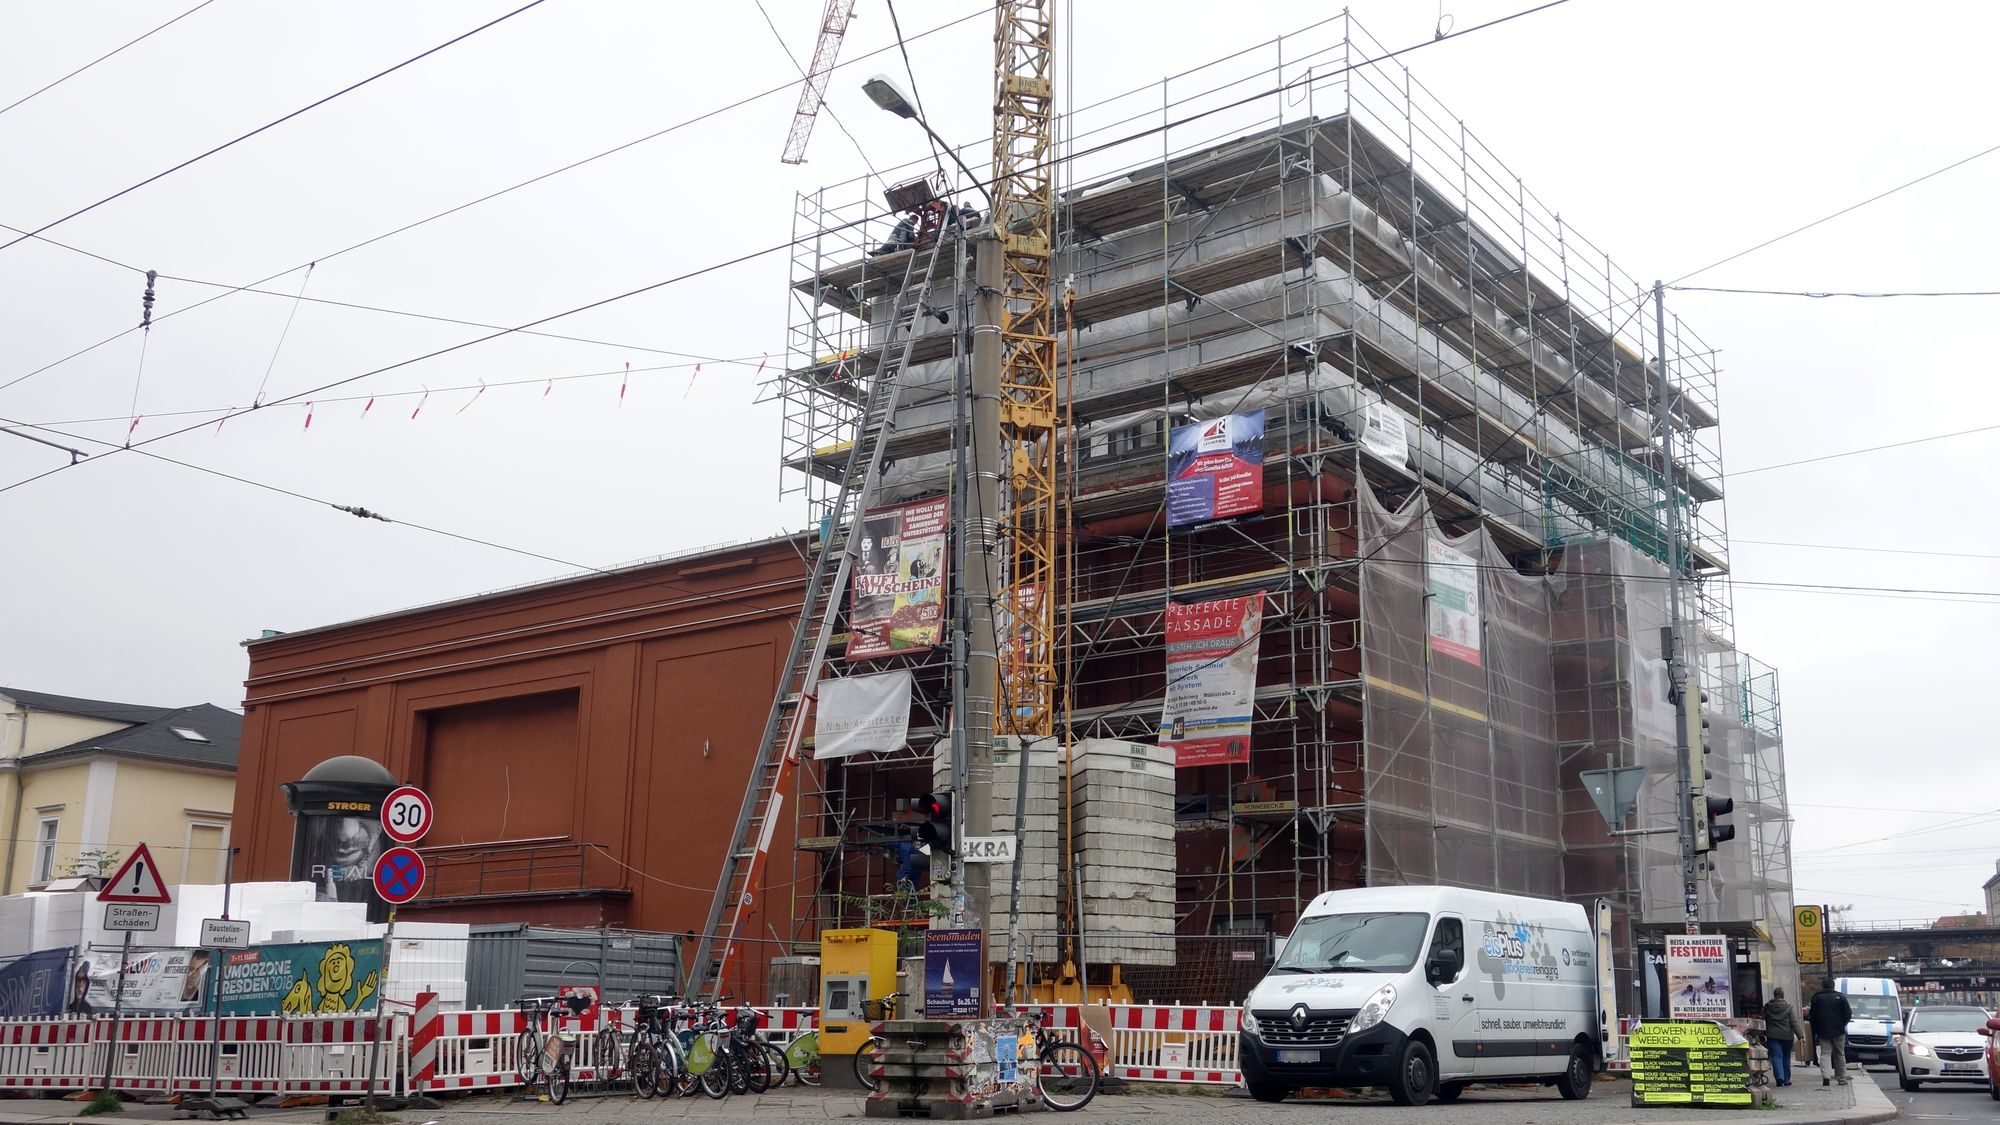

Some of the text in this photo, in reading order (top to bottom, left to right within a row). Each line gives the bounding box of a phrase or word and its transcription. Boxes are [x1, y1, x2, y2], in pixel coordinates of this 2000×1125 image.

[916, 506, 933, 514] WOLLT
[906, 514, 932, 523] WÄHREND
[908, 519, 938, 530] SANIERUNG
[855, 574, 898, 590] KAUFT
[859, 576, 940, 598] GUTSCHEINE
[1168, 598, 1240, 616] PERFEKTE
[1166, 616, 1237, 634] FASSADE.
[1177, 682, 1202, 691] System
[994, 738, 1008, 748] MS
[1131, 746, 1146, 755] BMS
[993, 754, 1007, 763] MS
[1131, 760, 1146, 770] BMS
[392, 802, 422, 828] 30
[113, 908, 152, 917] Straßen-
[112, 918, 150, 927] schäden
[208, 924, 243, 934] Baustellen-
[214, 935, 238, 944] einfahrt
[926, 931, 980, 942] Seenomaden
[1670, 946, 1724, 957] FESTIVAL
[270, 976, 294, 990] 2018
[1706, 998, 1726, 1006] 21.1.18
[1481, 1018, 1502, 1031] schnell,
[1502, 1019, 1522, 1032] sauber,
[1690, 1027, 1721, 1036] HALLO
[1638, 1036, 1682, 1044] WEEKEND
